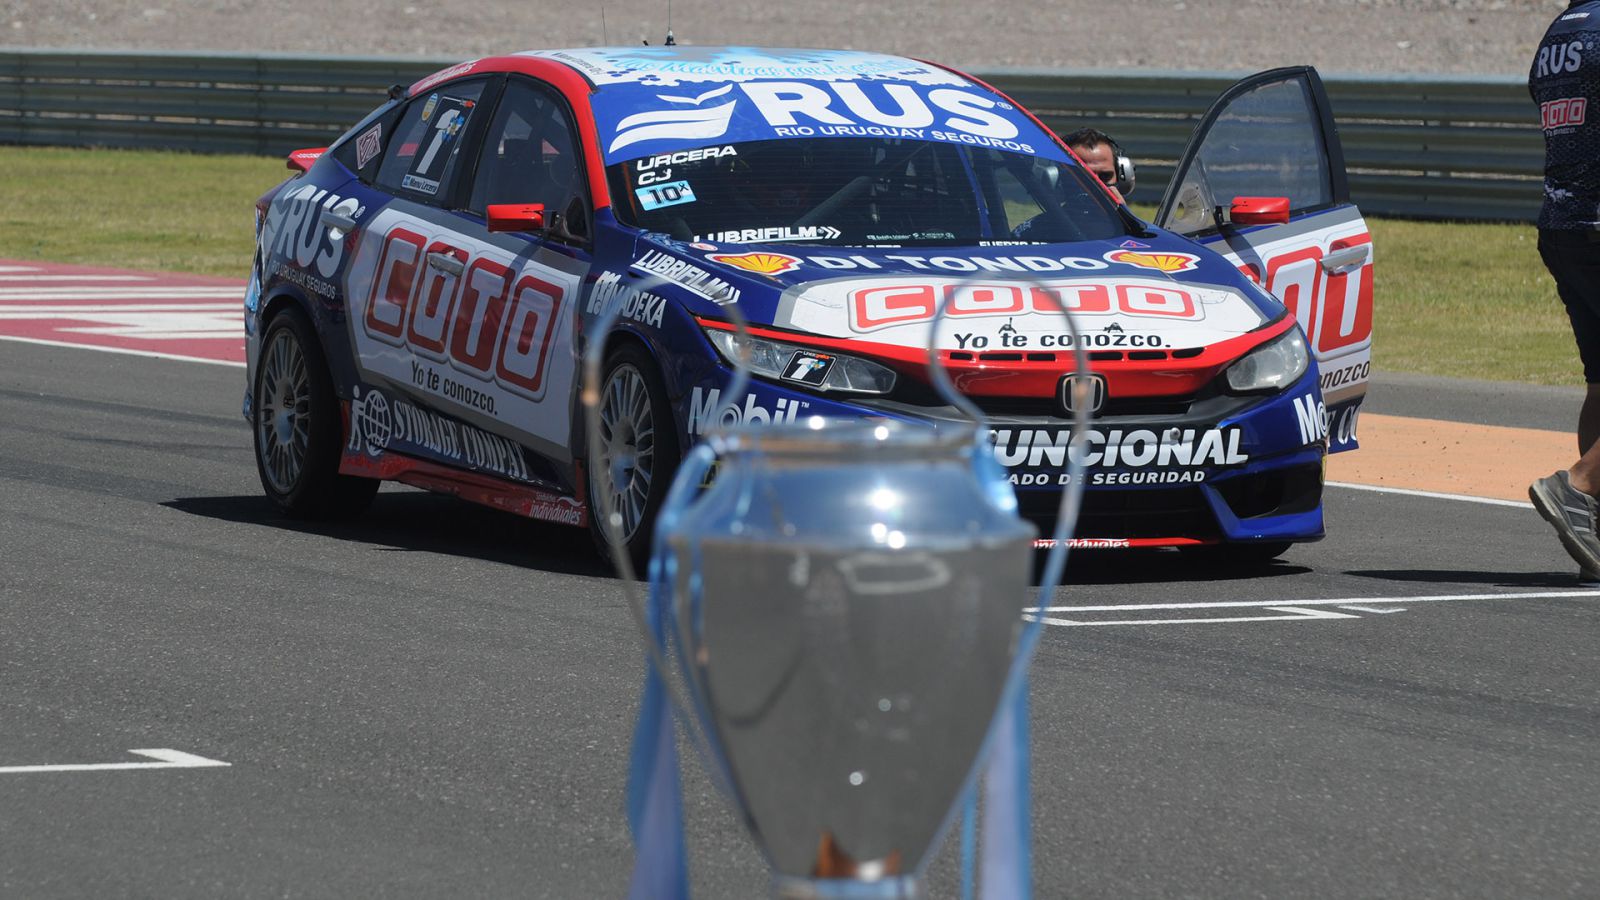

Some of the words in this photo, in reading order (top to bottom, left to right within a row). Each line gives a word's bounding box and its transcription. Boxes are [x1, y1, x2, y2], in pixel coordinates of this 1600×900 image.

[774, 125, 817, 137] RIO
[819, 125, 925, 139] URUGUAY
[931, 130, 1035, 154] SEGUROS
[636, 145, 738, 171] URCERA
[638, 168, 672, 185] CJ
[636, 249, 729, 296] LUBRIFILM
[807, 256, 882, 269] DI
[885, 255, 1109, 272] TONDO
[306, 274, 336, 300] SEGUROS
[366, 227, 564, 392] COTO
[855, 285, 1195, 328] COTO
[954, 333, 988, 349] Yo
[1002, 332, 1028, 347] te
[1040, 334, 1171, 348] conozco.
[411, 360, 425, 384] Yo
[427, 367, 440, 391] te
[443, 379, 498, 416] conozco.
[688, 386, 800, 434] Mobil
[986, 429, 1249, 467] UNCIONAL
[1058, 473, 1083, 485] DE
[1092, 471, 1206, 485] SEGURIDAD
